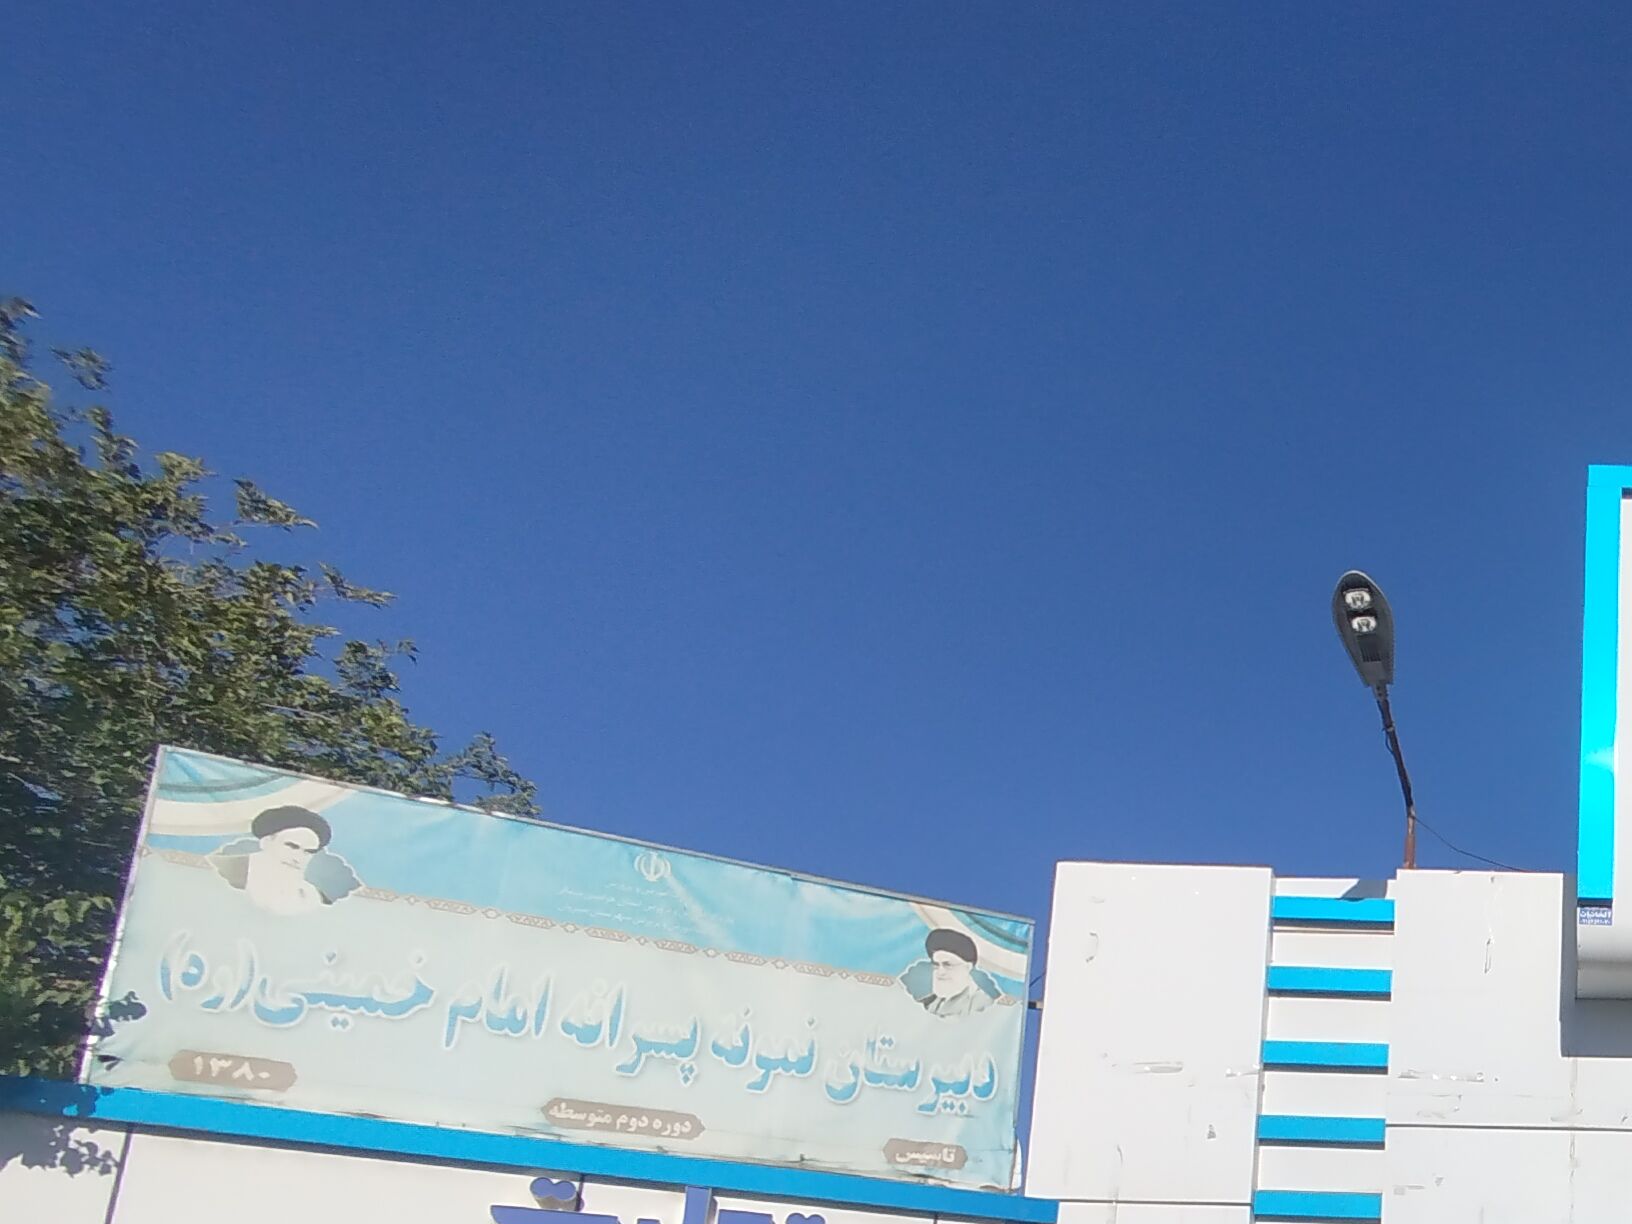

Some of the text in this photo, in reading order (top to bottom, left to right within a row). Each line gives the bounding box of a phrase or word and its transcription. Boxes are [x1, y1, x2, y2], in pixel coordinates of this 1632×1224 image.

[443, 962, 553, 1049] امام
[559, 974, 701, 1087] پسرانه
[710, 1005, 818, 1093] نمونه
[192, 1054, 272, 1083] ۱۳۸۰
[824, 1020, 998, 1115] دبیرستان
[548, 1101, 693, 1136] دوره دوم متوسطه
